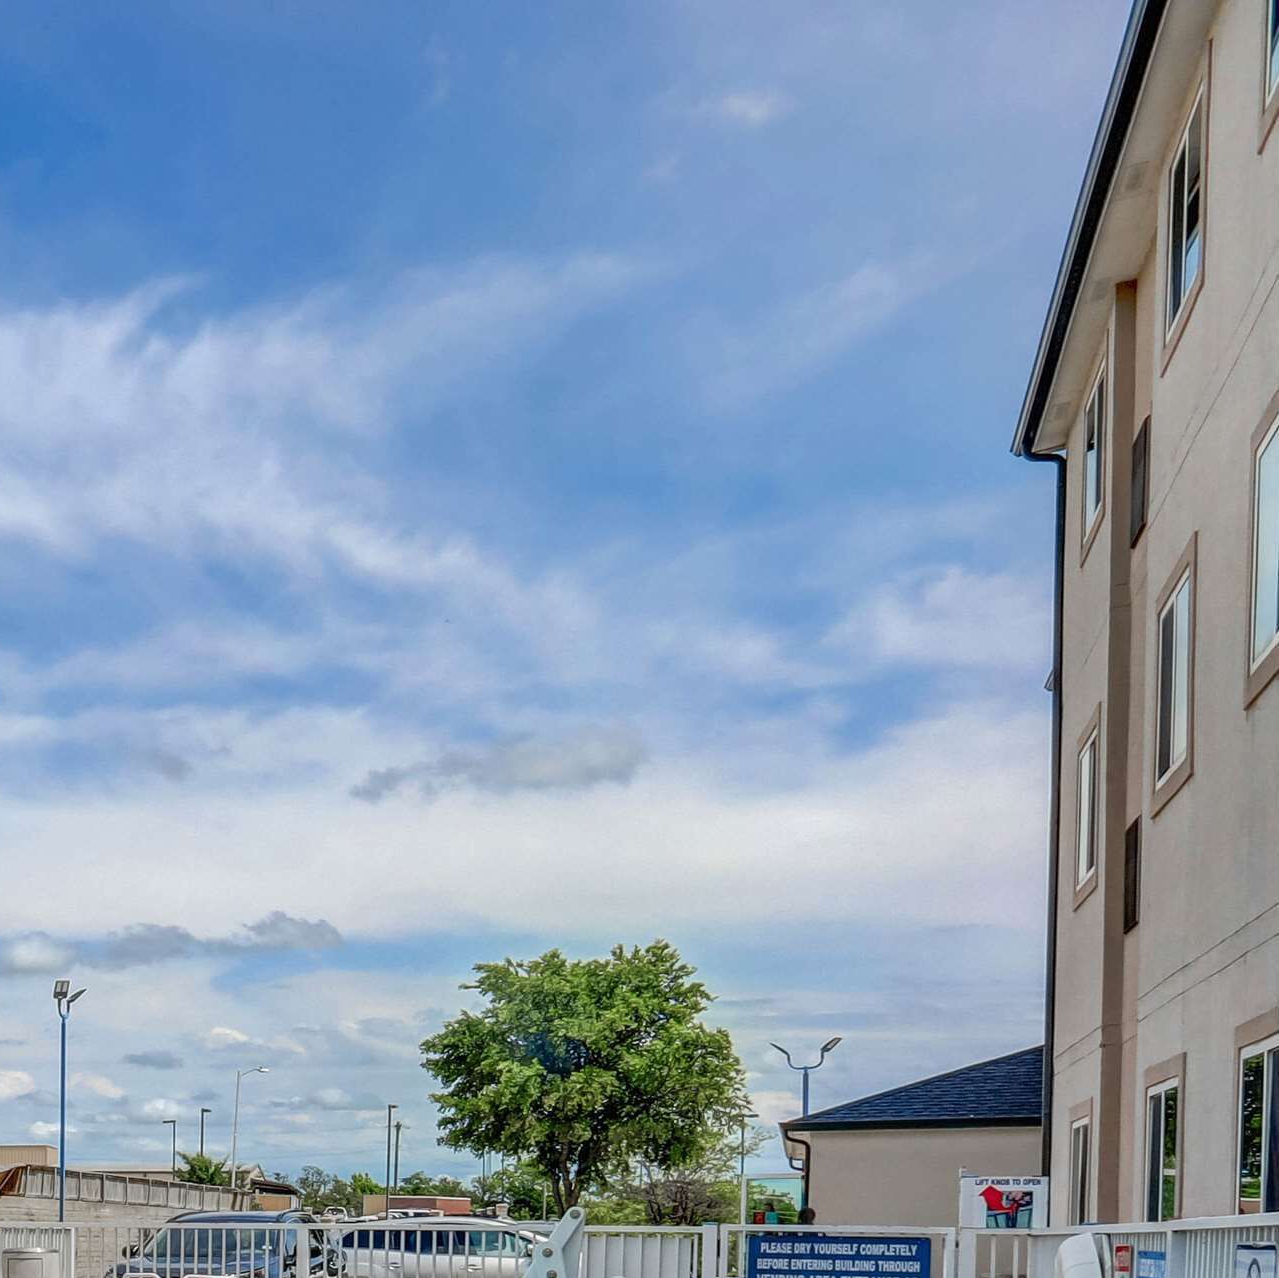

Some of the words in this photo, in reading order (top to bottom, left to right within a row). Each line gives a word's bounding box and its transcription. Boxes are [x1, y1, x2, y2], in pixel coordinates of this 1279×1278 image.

[760, 1242, 792, 1254] PLEASE
[794, 1243, 812, 1255] DRY
[813, 1243, 859, 1255] YOURSELF
[860, 1244, 918, 1256] COMPLETELY
[757, 1258, 789, 1270] BEFORE
[791, 1259, 833, 1271] ENTERING
[835, 1260, 876, 1272] BUILDING
[878, 1261, 920, 1273] THROUGH
